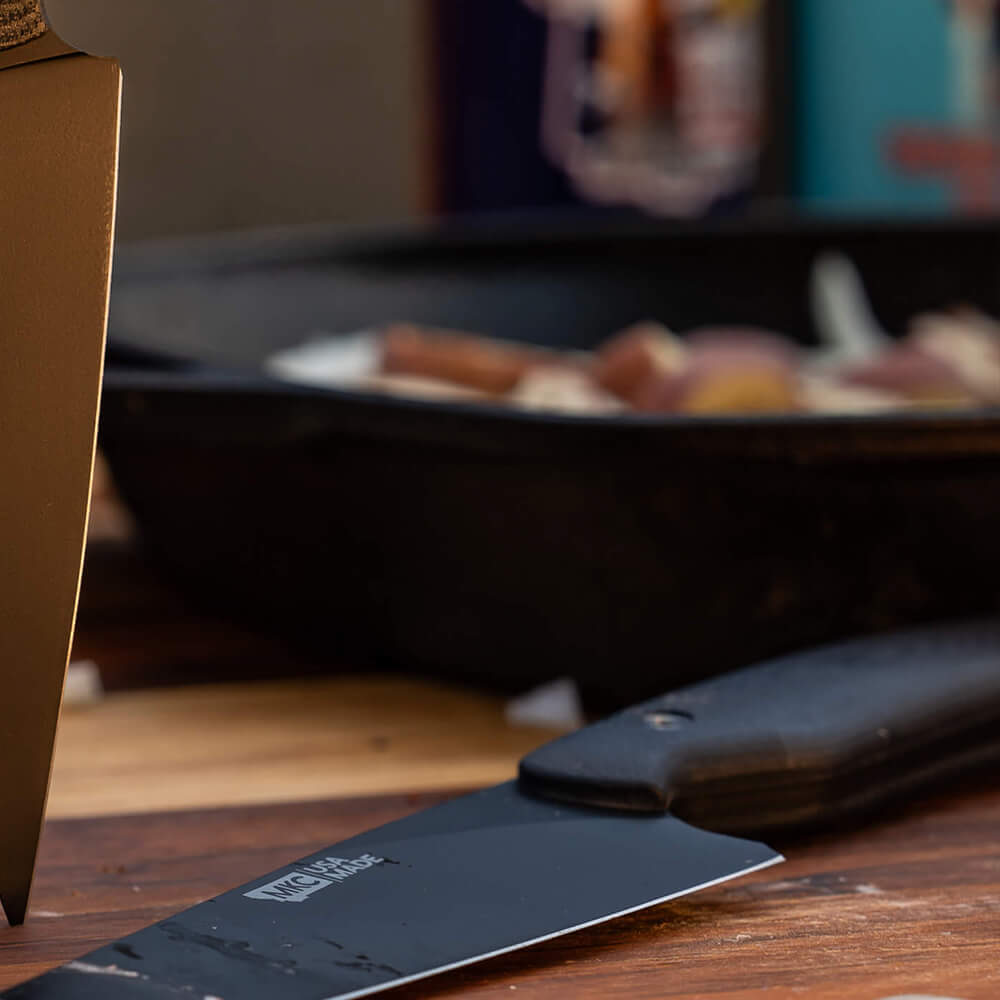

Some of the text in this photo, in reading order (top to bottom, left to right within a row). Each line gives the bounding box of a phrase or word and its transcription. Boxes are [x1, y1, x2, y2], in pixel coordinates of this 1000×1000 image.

[303, 856, 349, 874] USA
[323, 853, 385, 880] MADE
[261, 875, 321, 899] MKC
